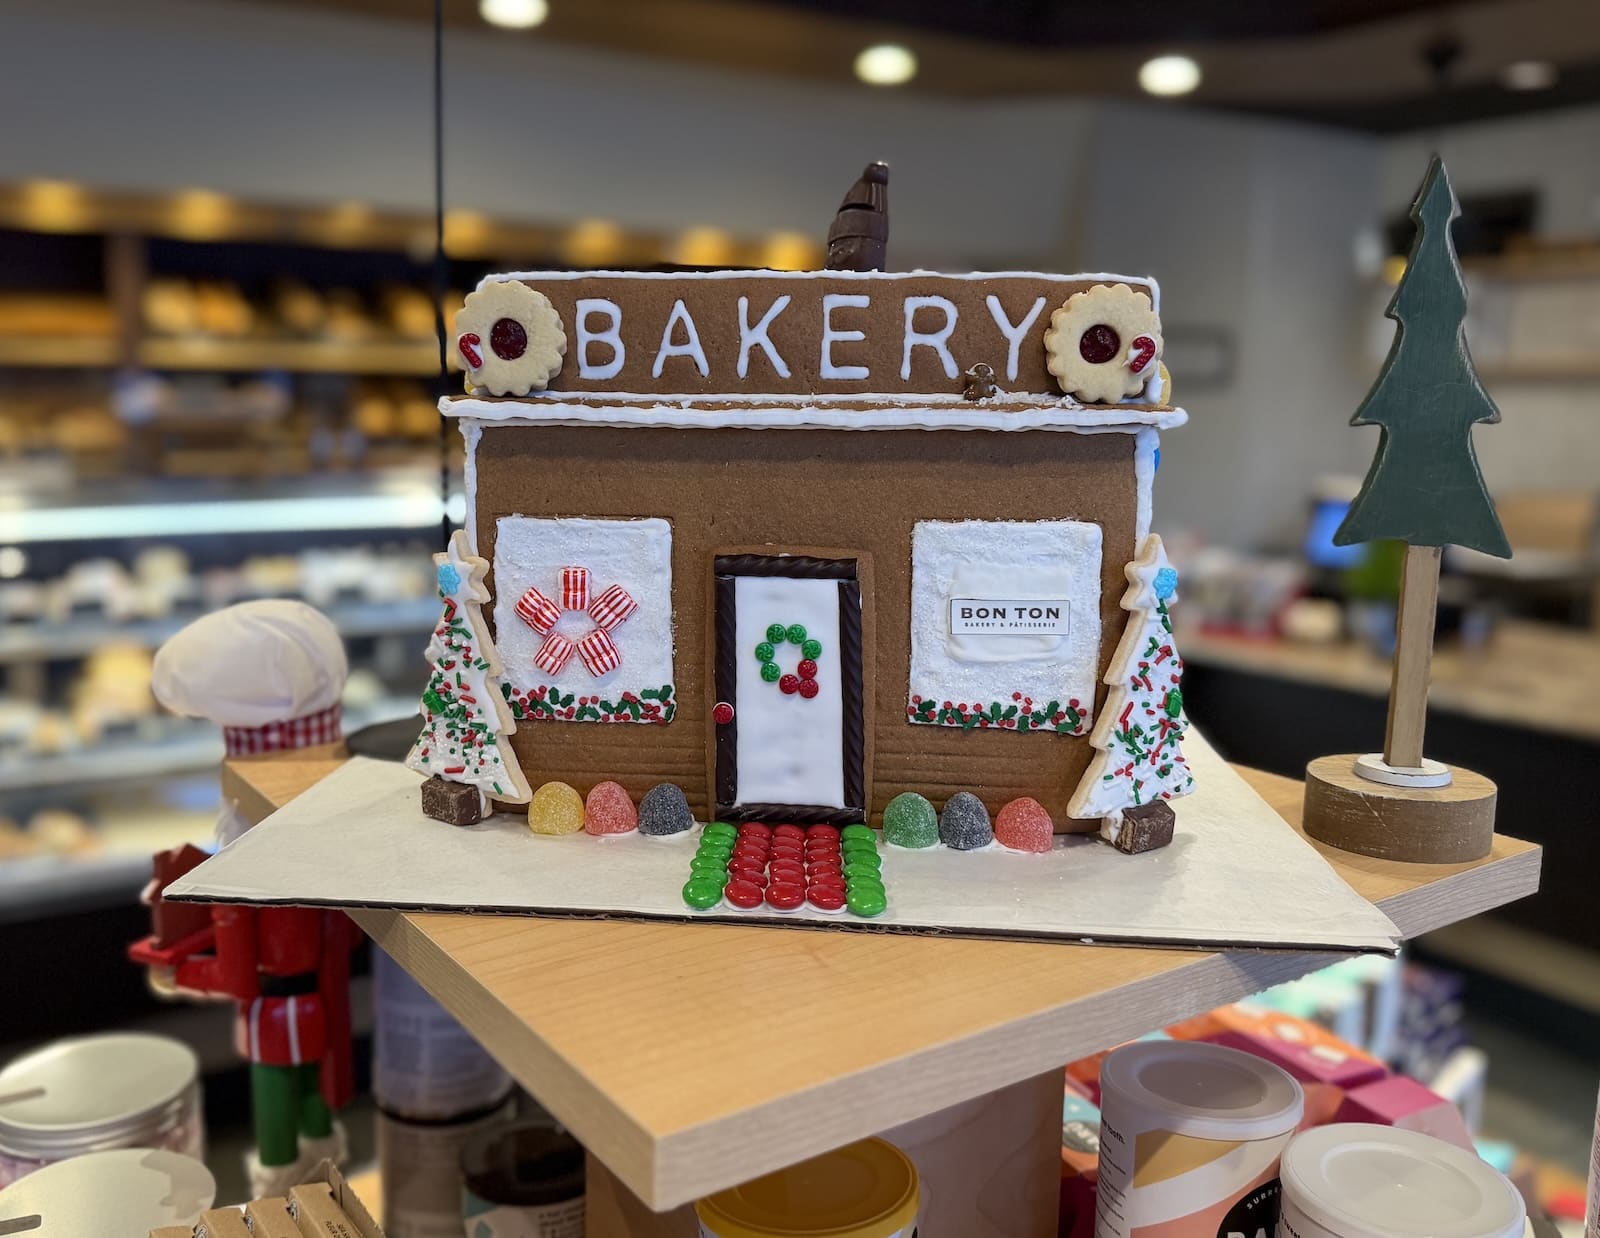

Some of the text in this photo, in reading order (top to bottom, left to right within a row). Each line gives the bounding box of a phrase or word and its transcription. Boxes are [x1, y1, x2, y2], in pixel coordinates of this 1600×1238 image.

[576, 294, 1047, 382] BAKERY
[961, 607, 1060, 619] BON TON
